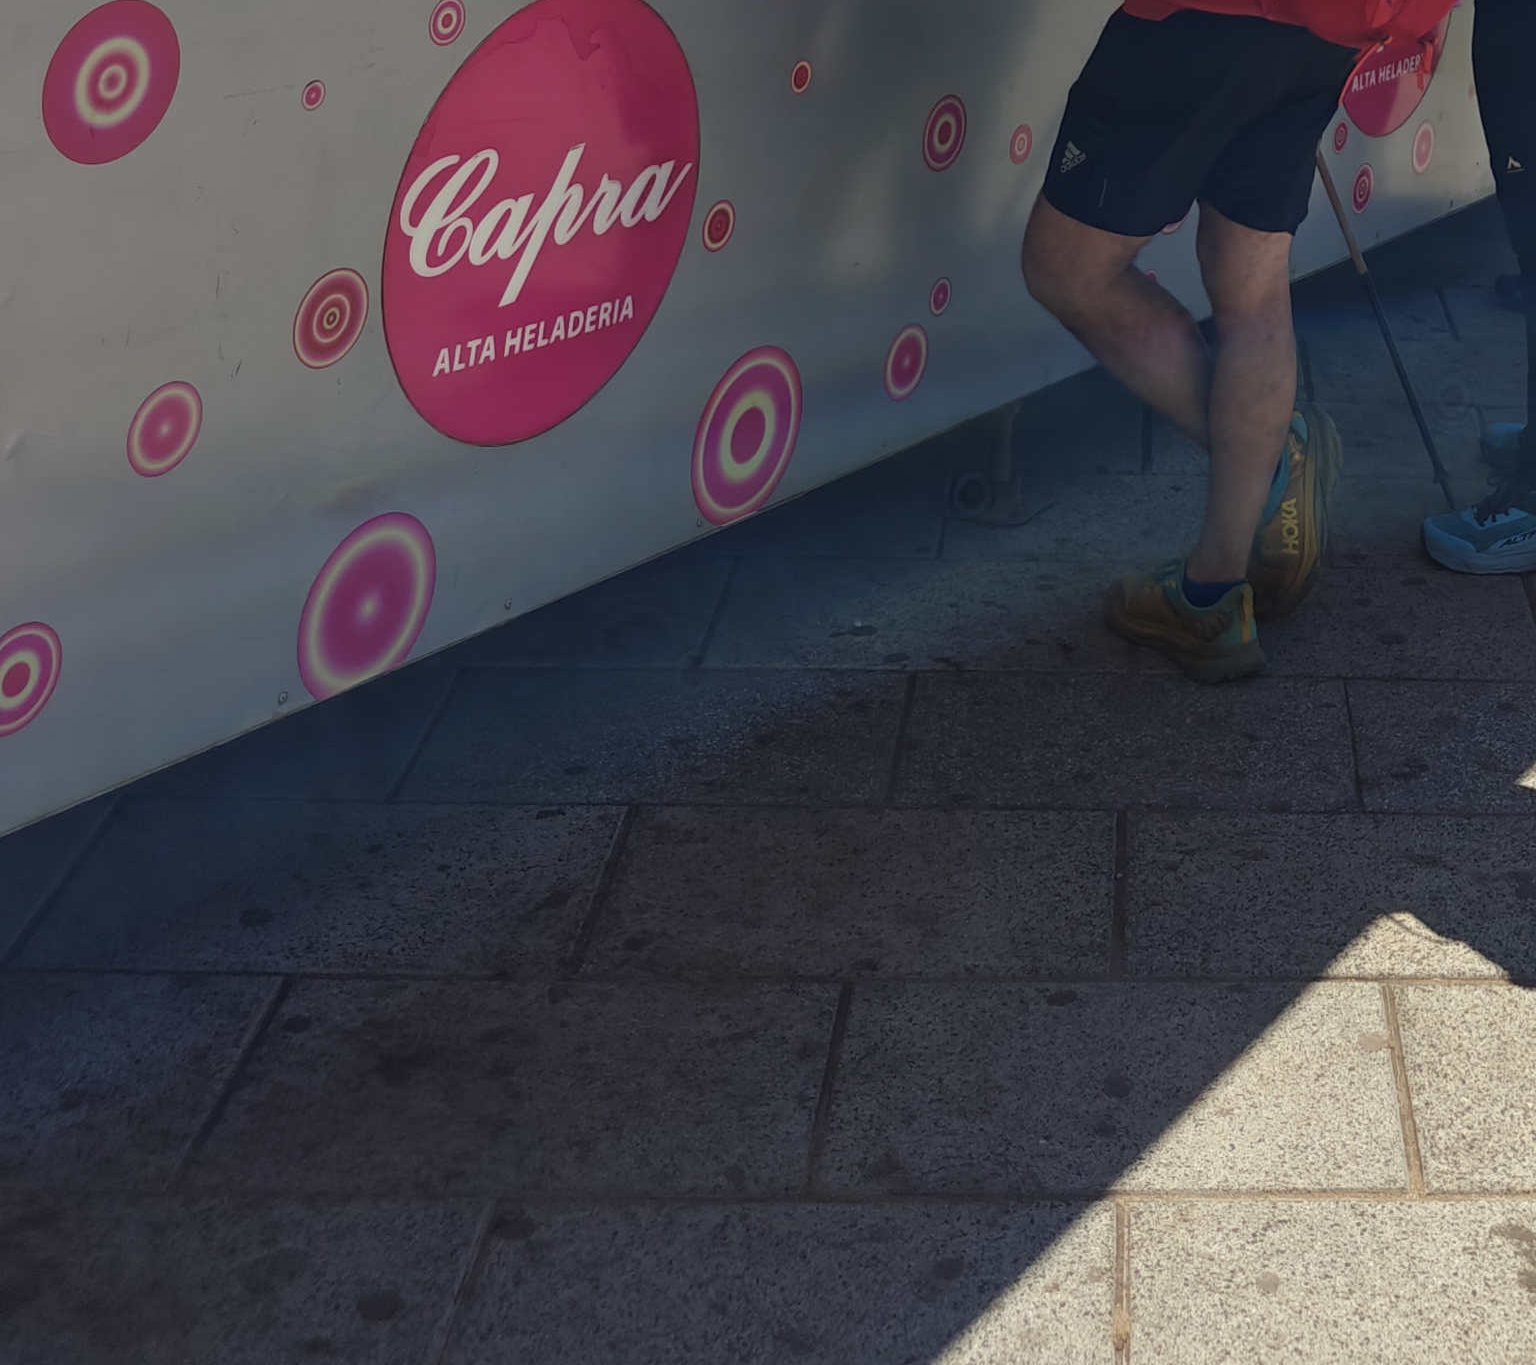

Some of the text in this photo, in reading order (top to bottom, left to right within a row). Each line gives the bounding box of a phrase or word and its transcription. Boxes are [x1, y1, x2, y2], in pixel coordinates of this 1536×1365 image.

[1351, 52, 1424, 93] ALTA HELADER
[400, 142, 693, 308] Capra
[432, 295, 634, 377] ALTA HELADERIA
[1281, 497, 1299, 555] HOKA
